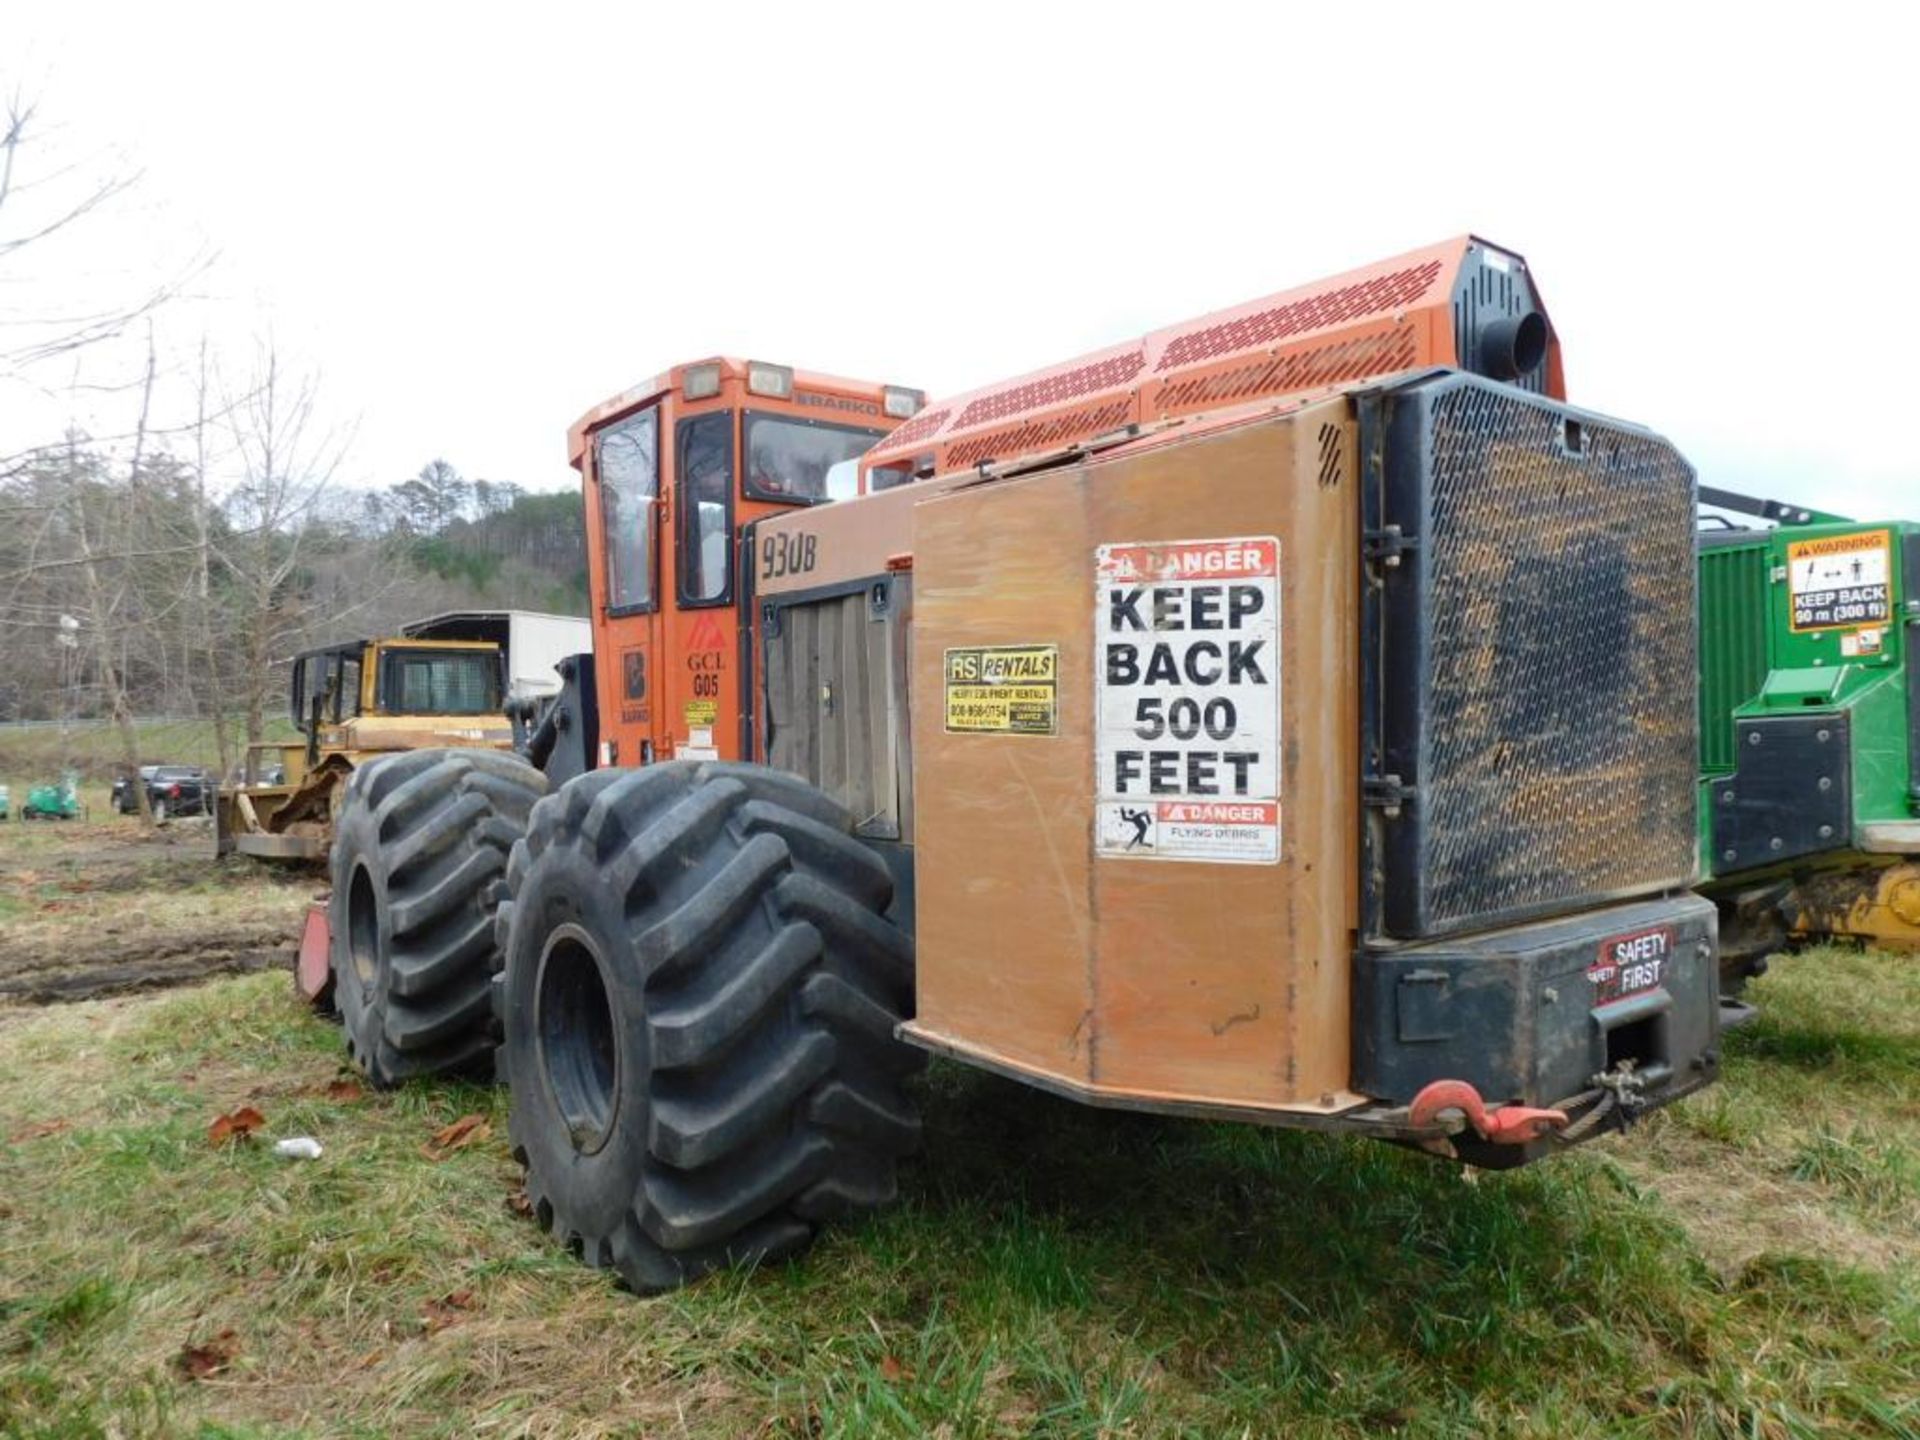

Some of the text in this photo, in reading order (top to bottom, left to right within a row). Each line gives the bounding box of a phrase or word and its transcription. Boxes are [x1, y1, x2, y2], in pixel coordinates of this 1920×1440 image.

[810, 394, 880, 416] BARKO
[1811, 534, 1883, 555] WARNING
[1145, 550, 1262, 572] DANGER
[1110, 585, 1265, 632] KEEP
[1795, 586, 1885, 609] KEEP BACK
[1795, 602, 1887, 624] 90 m (300 ft)
[951, 655, 1051, 680] RS RENTALS
[1106, 639, 1269, 687] BACK
[1133, 696, 1238, 741] 500
[1115, 750, 1260, 796] FEET
[1190, 804, 1266, 822] DANGER
[1171, 827, 1261, 840] FLYING DEBRIS
[1615, 932, 1668, 966] SAFETY
[1621, 959, 1662, 994] FIRST
